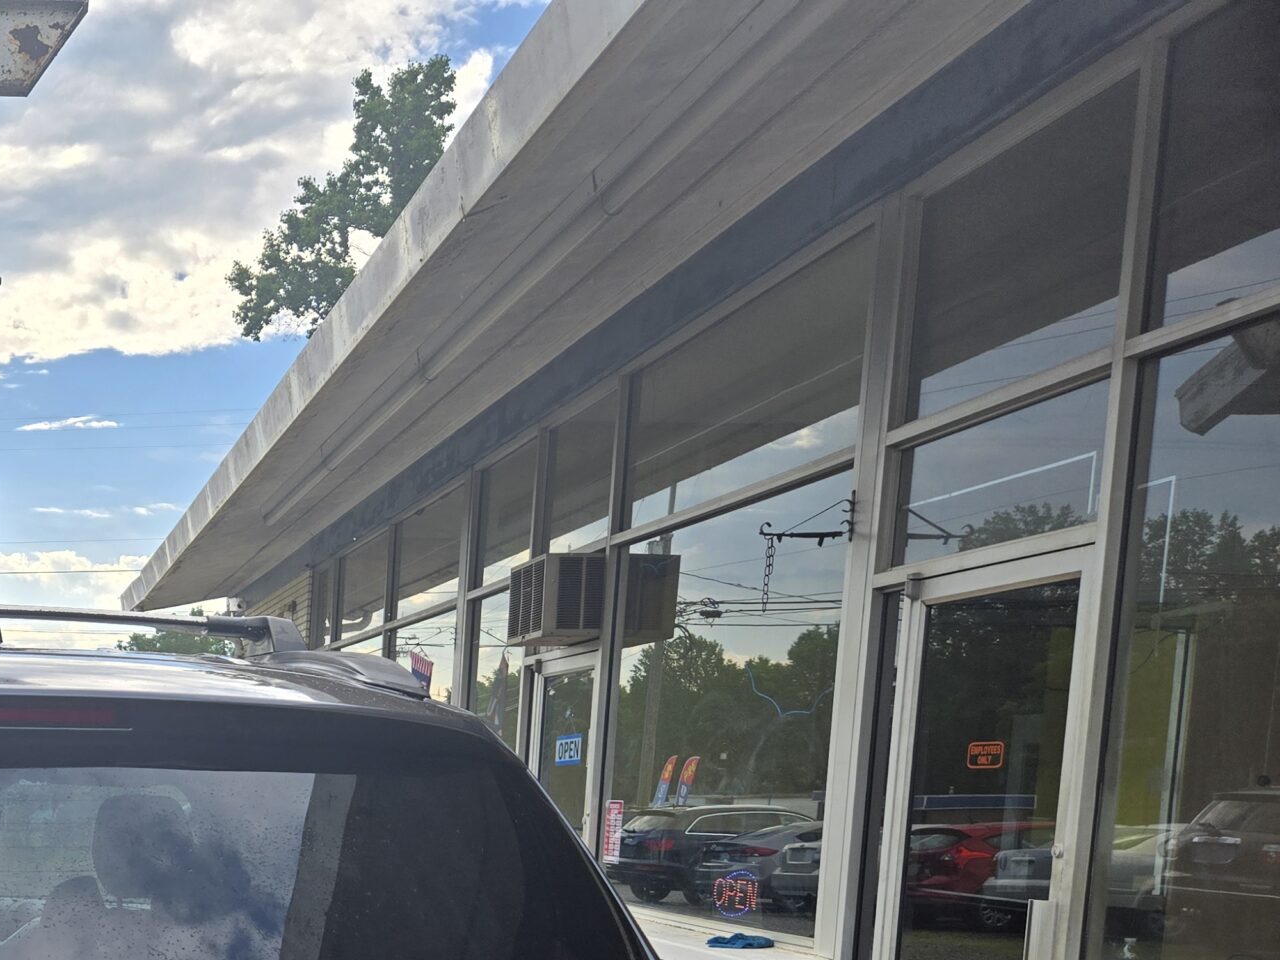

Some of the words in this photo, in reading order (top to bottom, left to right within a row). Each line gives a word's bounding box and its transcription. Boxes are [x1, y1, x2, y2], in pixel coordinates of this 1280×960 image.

[558, 740, 580, 760] OPEN
[970, 745, 1001, 755] EMPLOYEES
[977, 755, 992, 765] ONLY
[713, 878, 758, 911] OPEN
